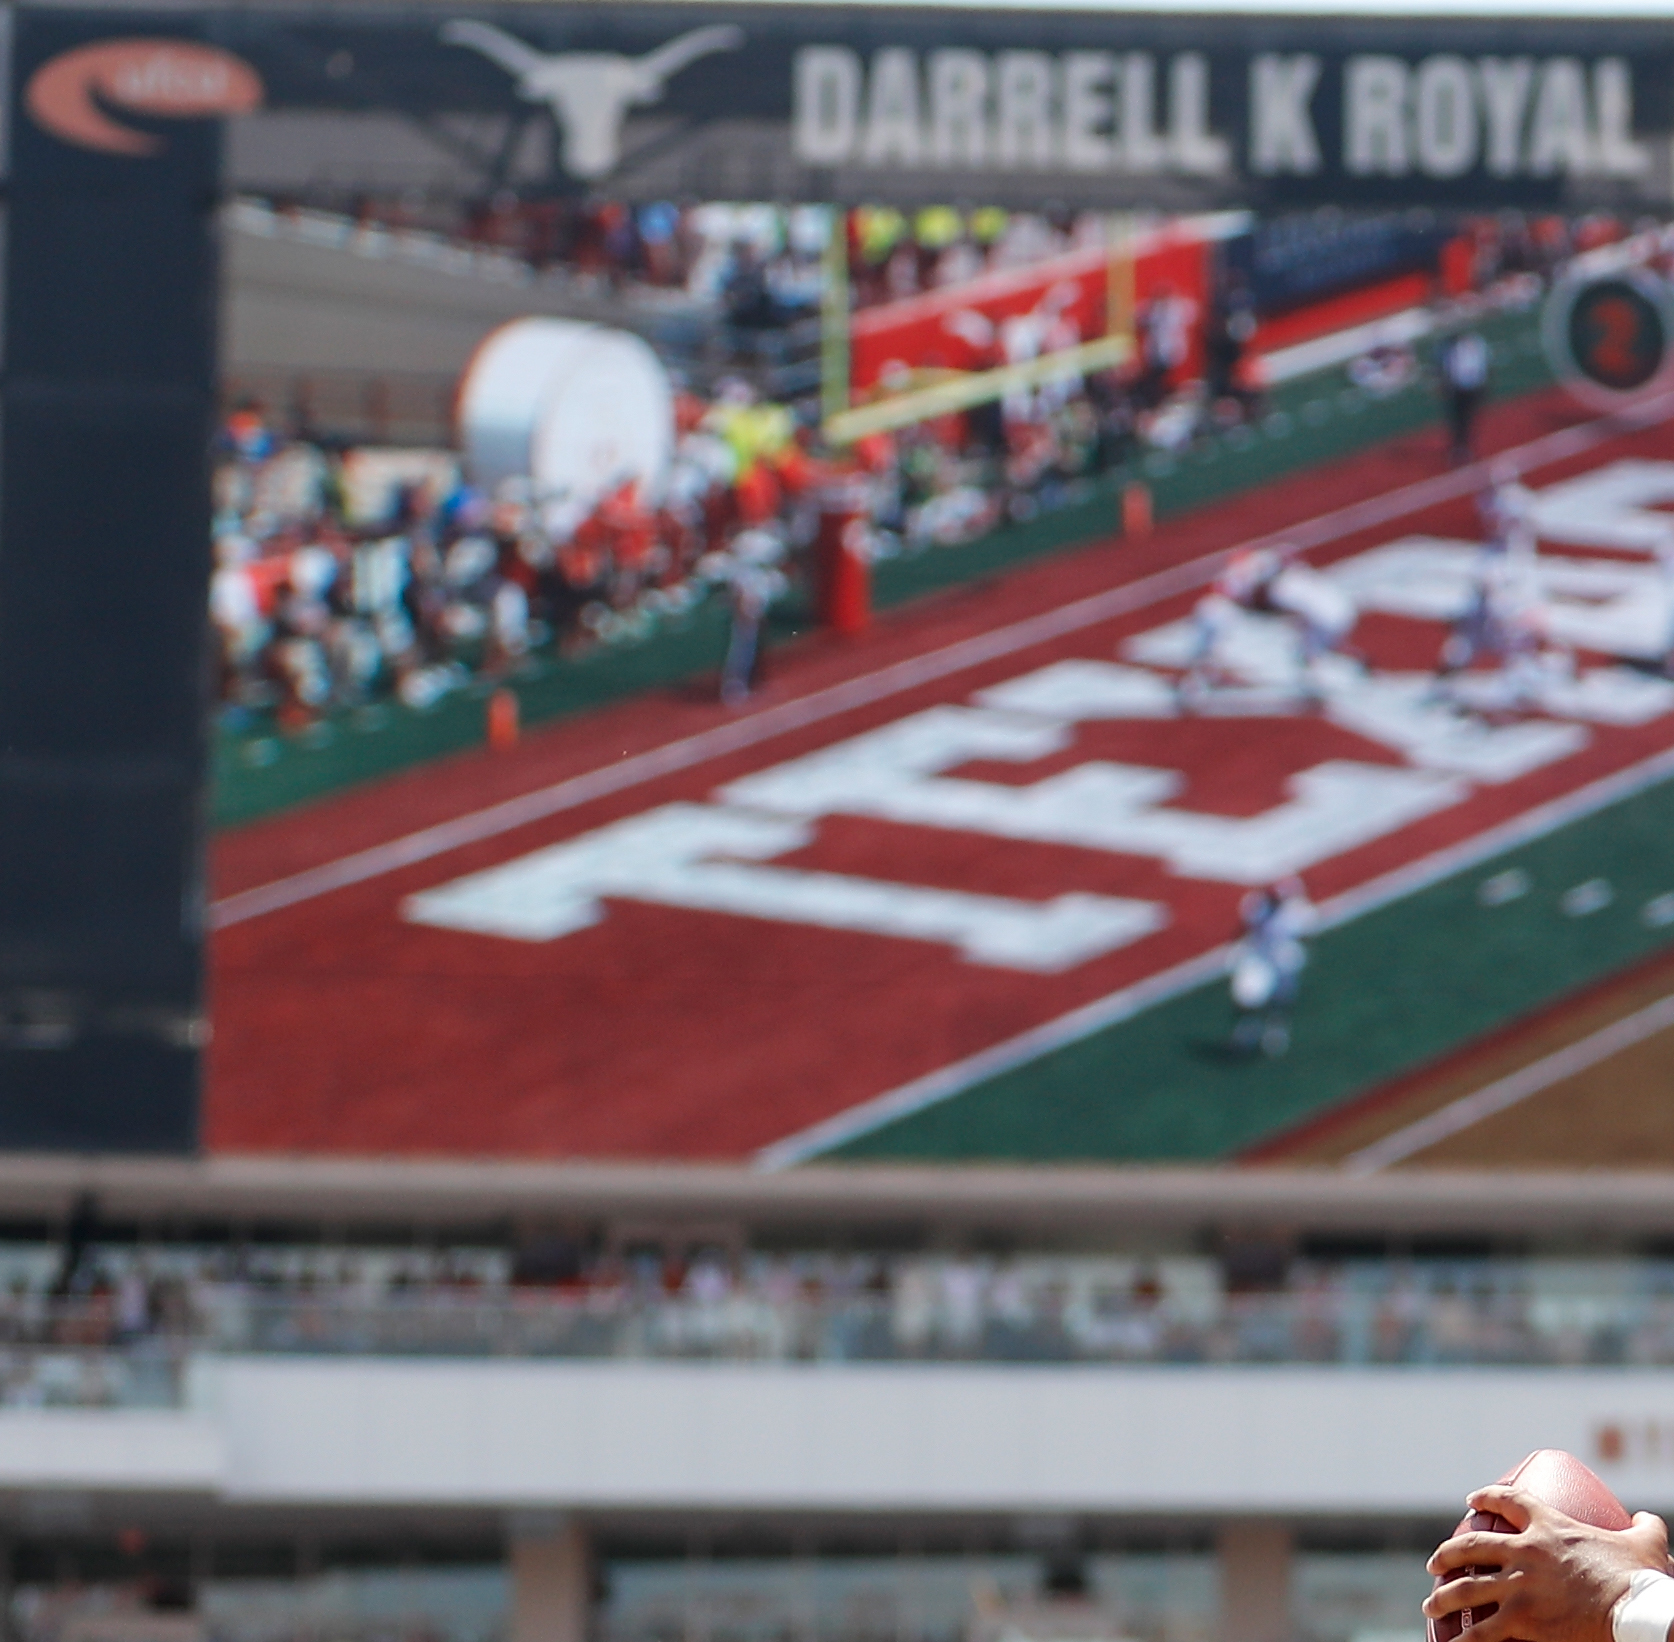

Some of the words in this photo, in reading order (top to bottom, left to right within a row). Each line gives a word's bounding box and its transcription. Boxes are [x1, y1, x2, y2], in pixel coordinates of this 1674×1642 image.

[797, 45, 1229, 172] DARRELL
[1247, 50, 1322, 175] K
[1344, 53, 1649, 177] ROYAL
